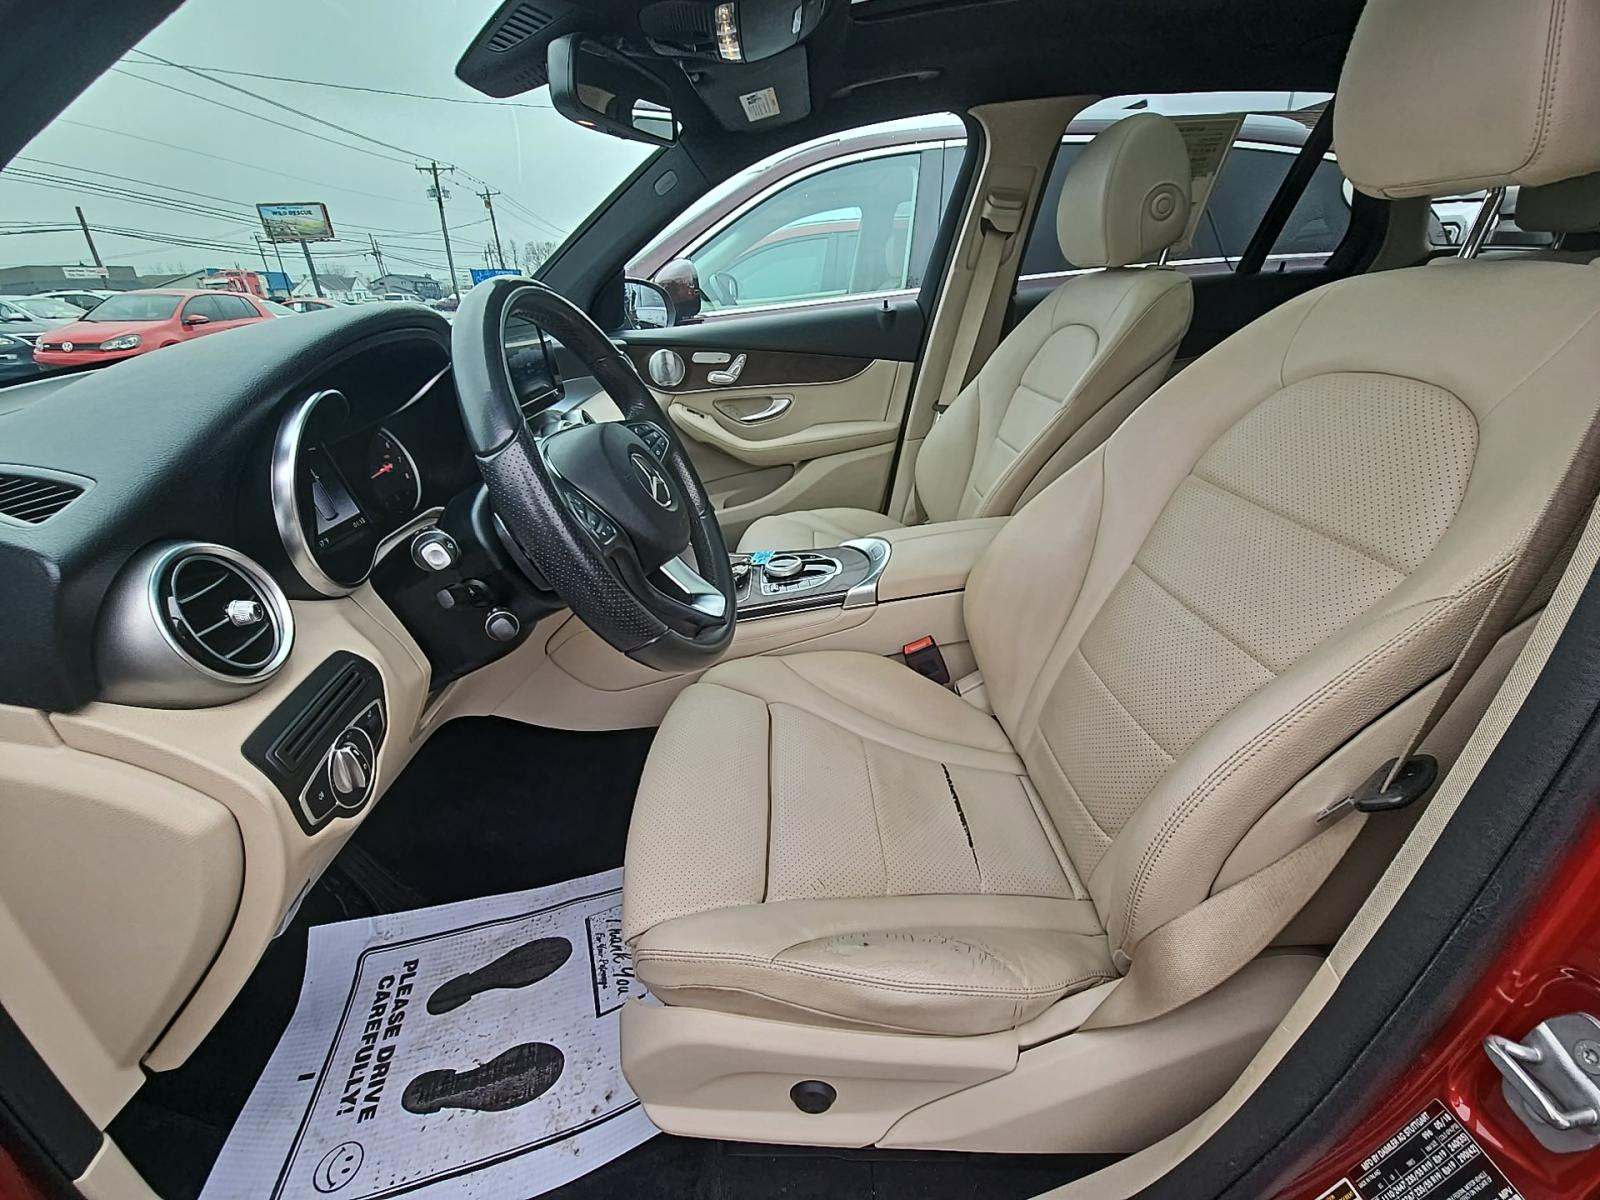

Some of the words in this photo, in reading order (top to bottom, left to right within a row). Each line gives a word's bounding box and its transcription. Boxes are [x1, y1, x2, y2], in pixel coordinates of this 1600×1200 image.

[382, 958, 420, 1041] PLEASE
[613, 967, 635, 996] You
[336, 974, 395, 1117] CAREFULLY!
[357, 1044, 396, 1124] DRIVE
[1377, 1137, 1400, 1159] DAIMLER
[1397, 1132, 1407, 1144] AG
[1403, 1111, 1430, 1137] STUTTGART
